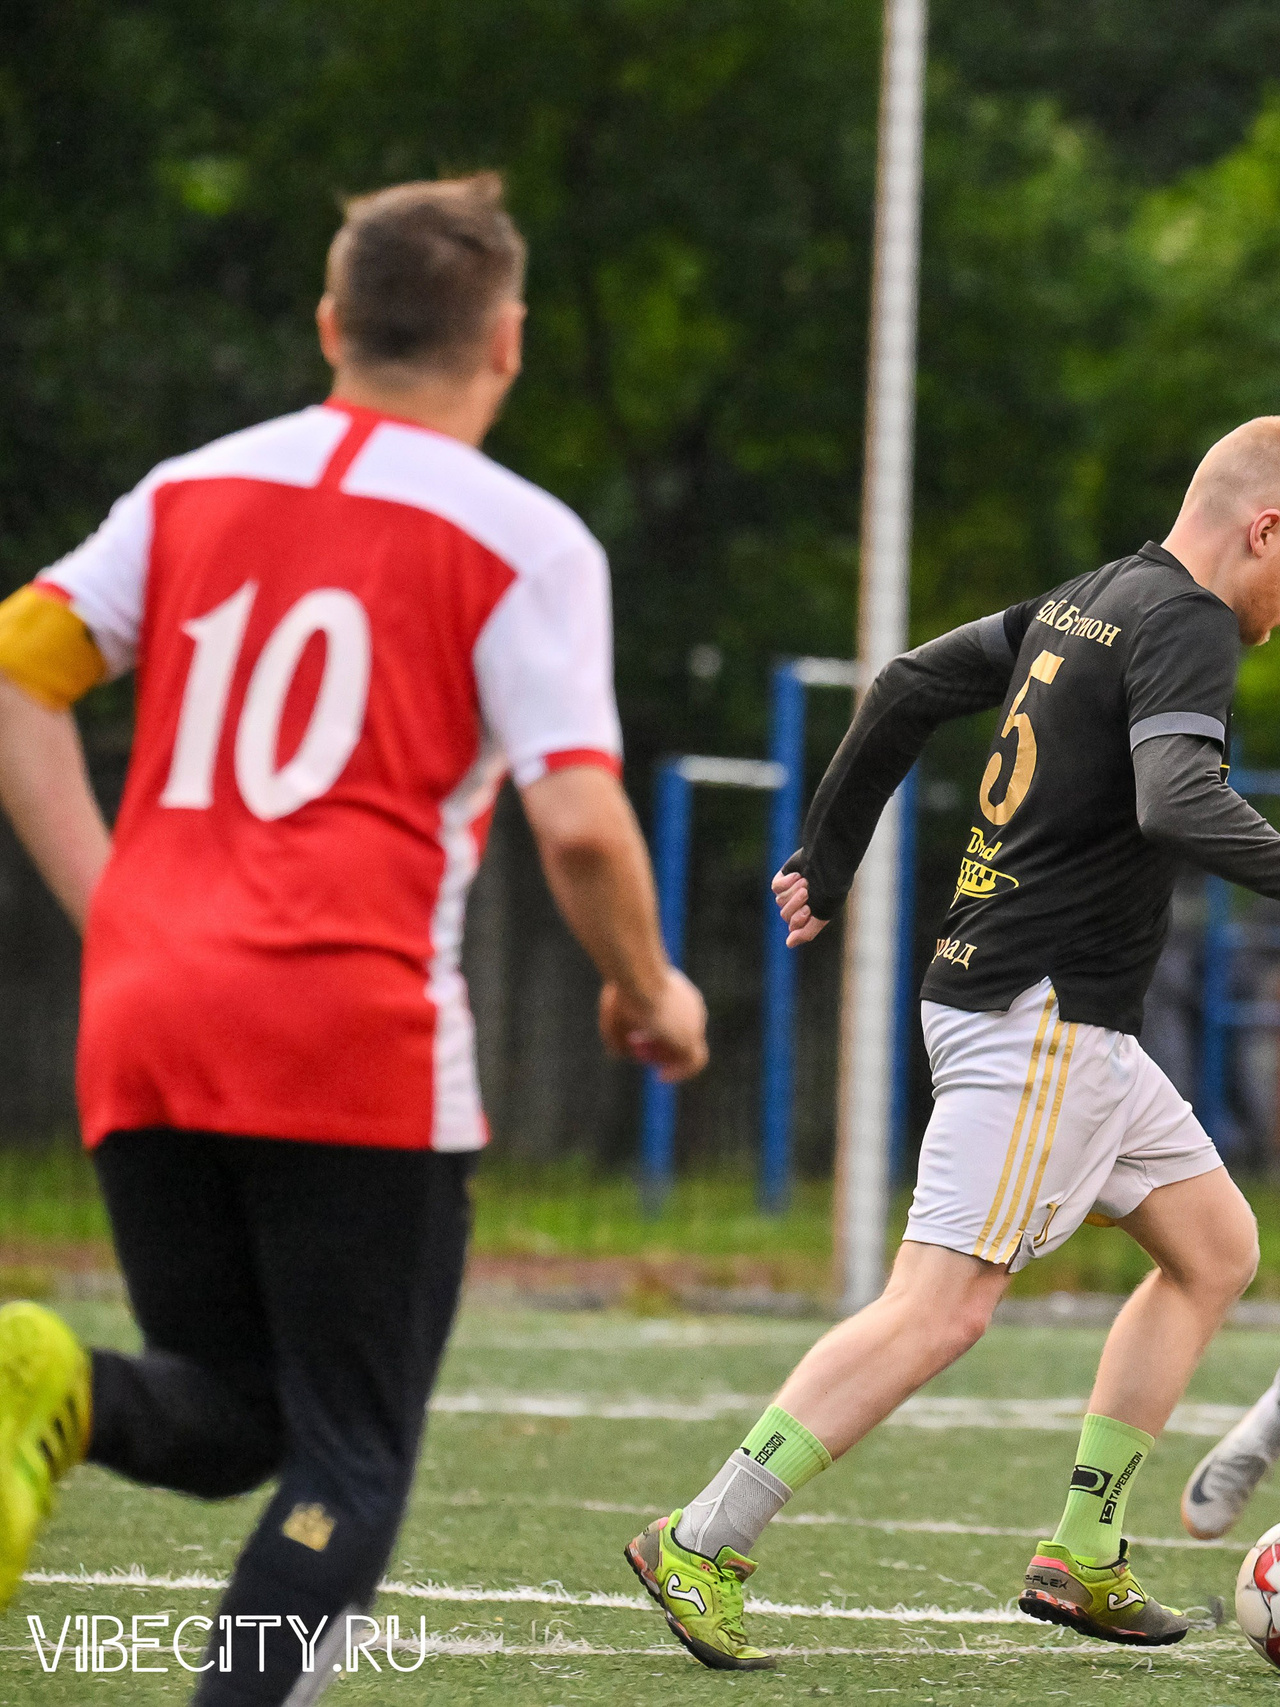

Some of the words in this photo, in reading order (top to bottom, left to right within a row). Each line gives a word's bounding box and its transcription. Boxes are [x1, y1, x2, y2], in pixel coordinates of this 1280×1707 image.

[160, 578, 373, 822] 10
[979, 650, 1065, 826] 5
[1108, 1451, 1143, 1500] TAPEDESIGN
